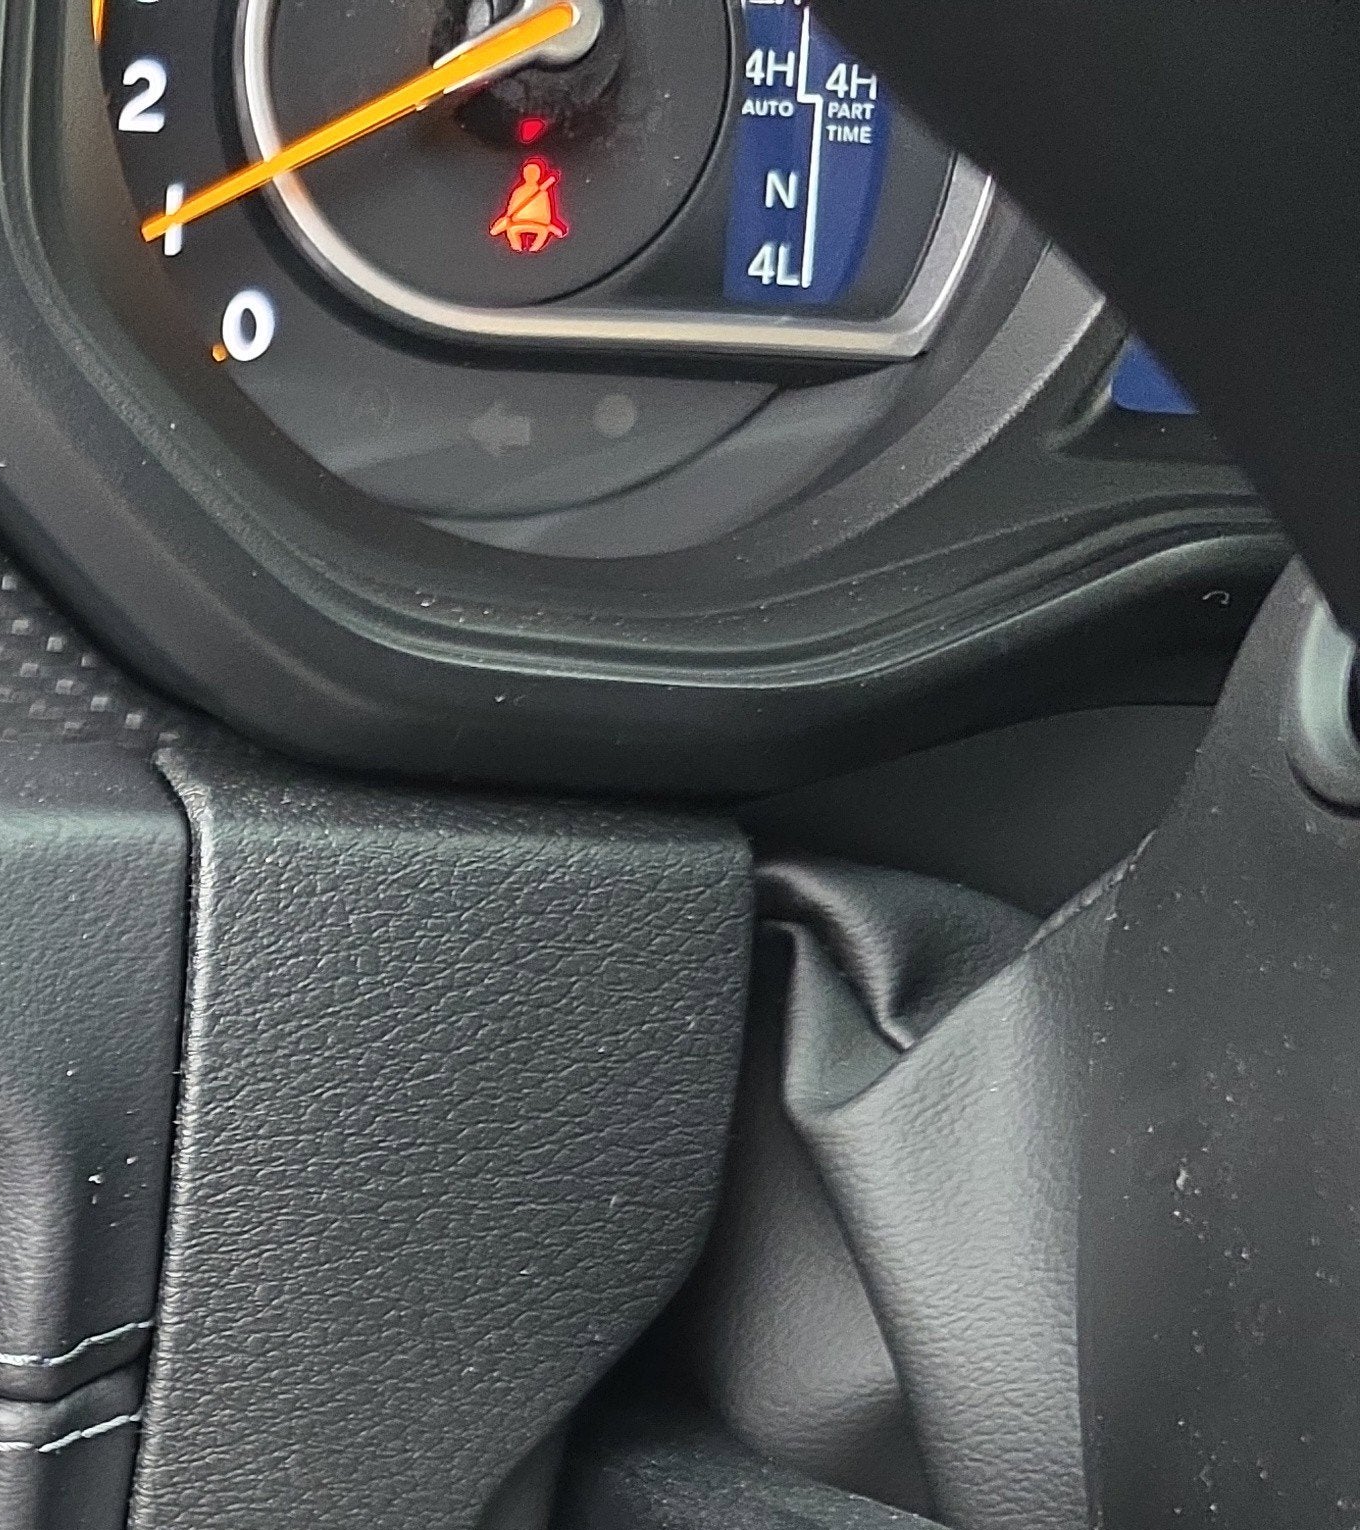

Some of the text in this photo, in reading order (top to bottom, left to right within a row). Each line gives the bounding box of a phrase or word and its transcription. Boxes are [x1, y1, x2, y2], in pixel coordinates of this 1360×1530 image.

[745, 48, 795, 87] 4H
[825, 63, 877, 100] 4H
[118, 58, 167, 133] 2
[741, 99, 795, 117] AUTO
[827, 102, 875, 120] PART
[826, 125, 873, 144] TIME
[765, 170, 798, 209] N
[164, 182, 184, 257] 1
[747, 243, 800, 286] 4L
[222, 288, 275, 362] 0
